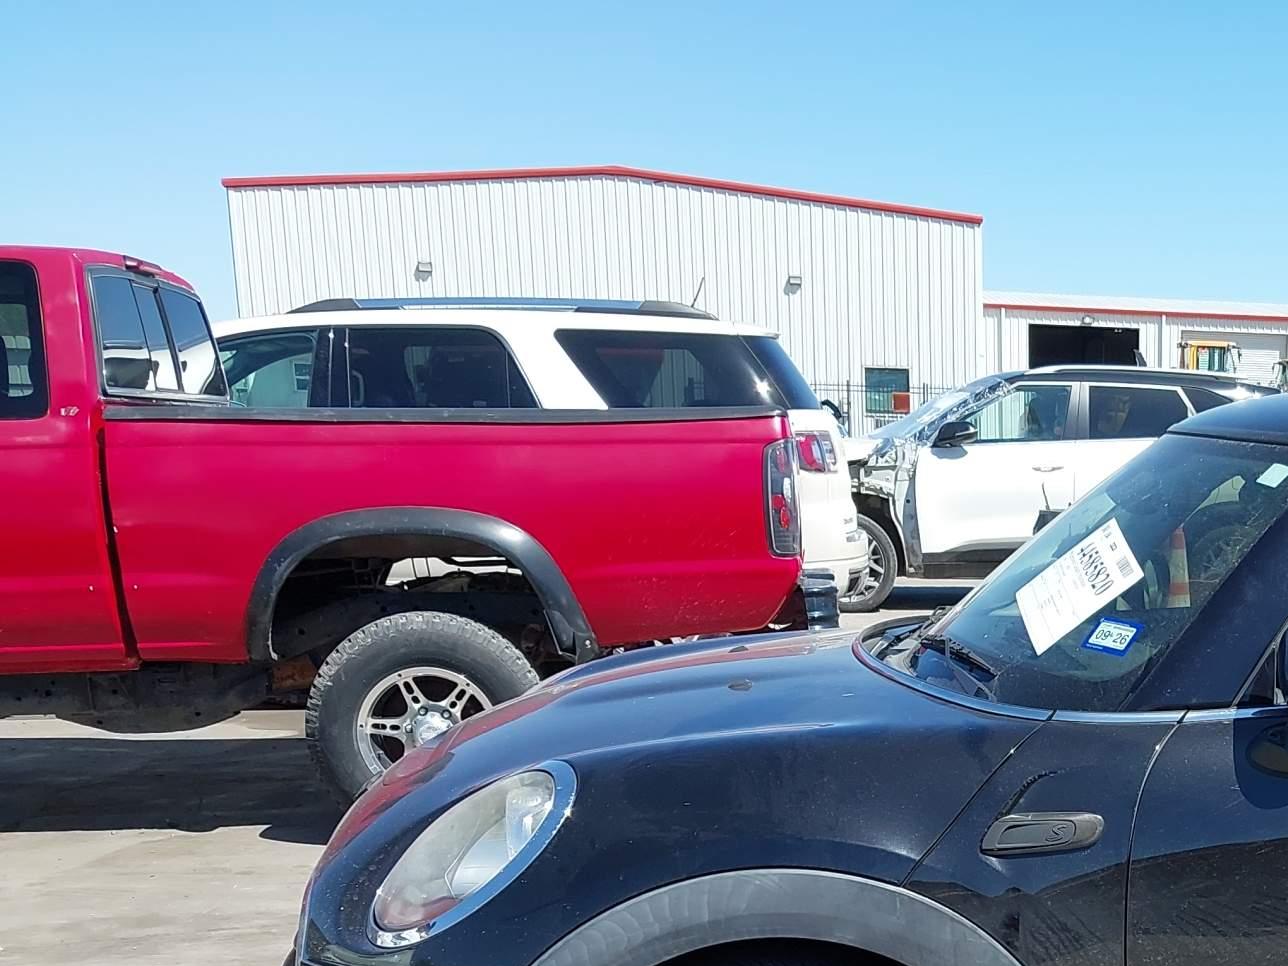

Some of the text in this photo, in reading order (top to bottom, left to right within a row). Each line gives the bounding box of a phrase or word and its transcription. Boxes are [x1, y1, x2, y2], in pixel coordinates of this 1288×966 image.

[1077, 542, 1114, 596] 44585820
[1095, 629, 1111, 641] 09
[1111, 632, 1130, 645] 26
[1045, 824, 1068, 842] S
